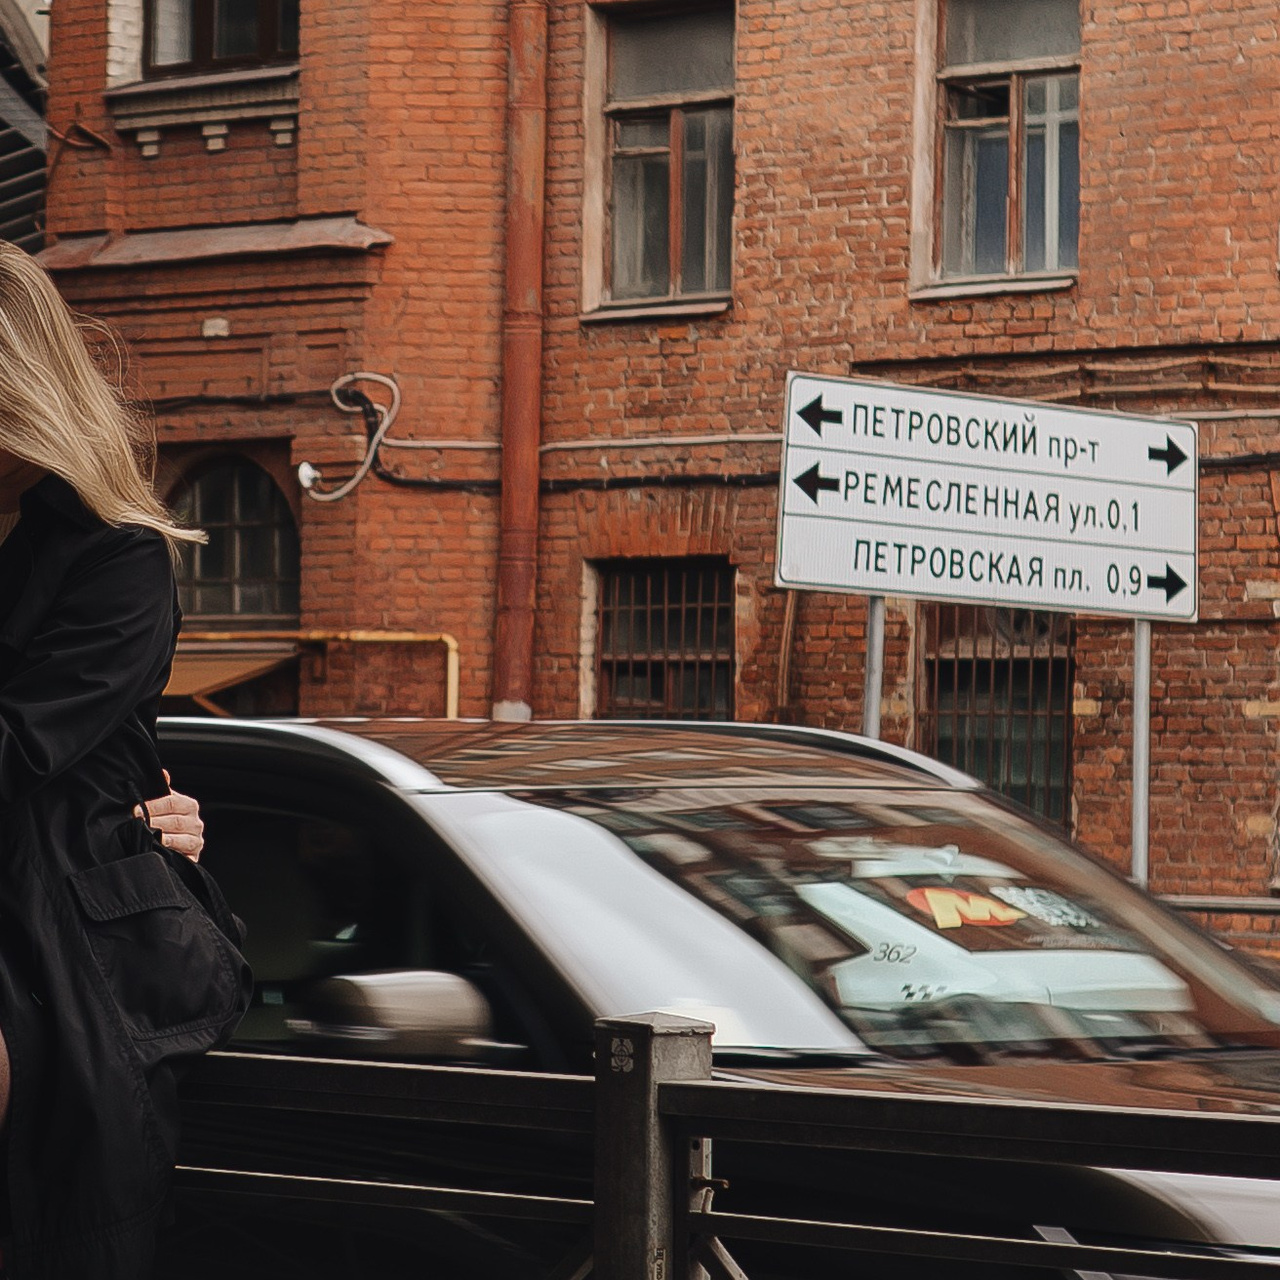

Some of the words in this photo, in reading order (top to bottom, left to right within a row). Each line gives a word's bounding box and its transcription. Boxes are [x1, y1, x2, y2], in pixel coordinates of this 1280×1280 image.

[852, 404, 1038, 456] ПЕТРОВСКИЙ
[1048, 435, 1100, 468] пр-т
[844, 470, 1061, 523] РЕМЕСЛЕННАЯ
[854, 540, 1044, 586] ПЕТРОВСКАЯ
[1055, 568, 1091, 592] пл.
[873, 942, 917, 964] 362
